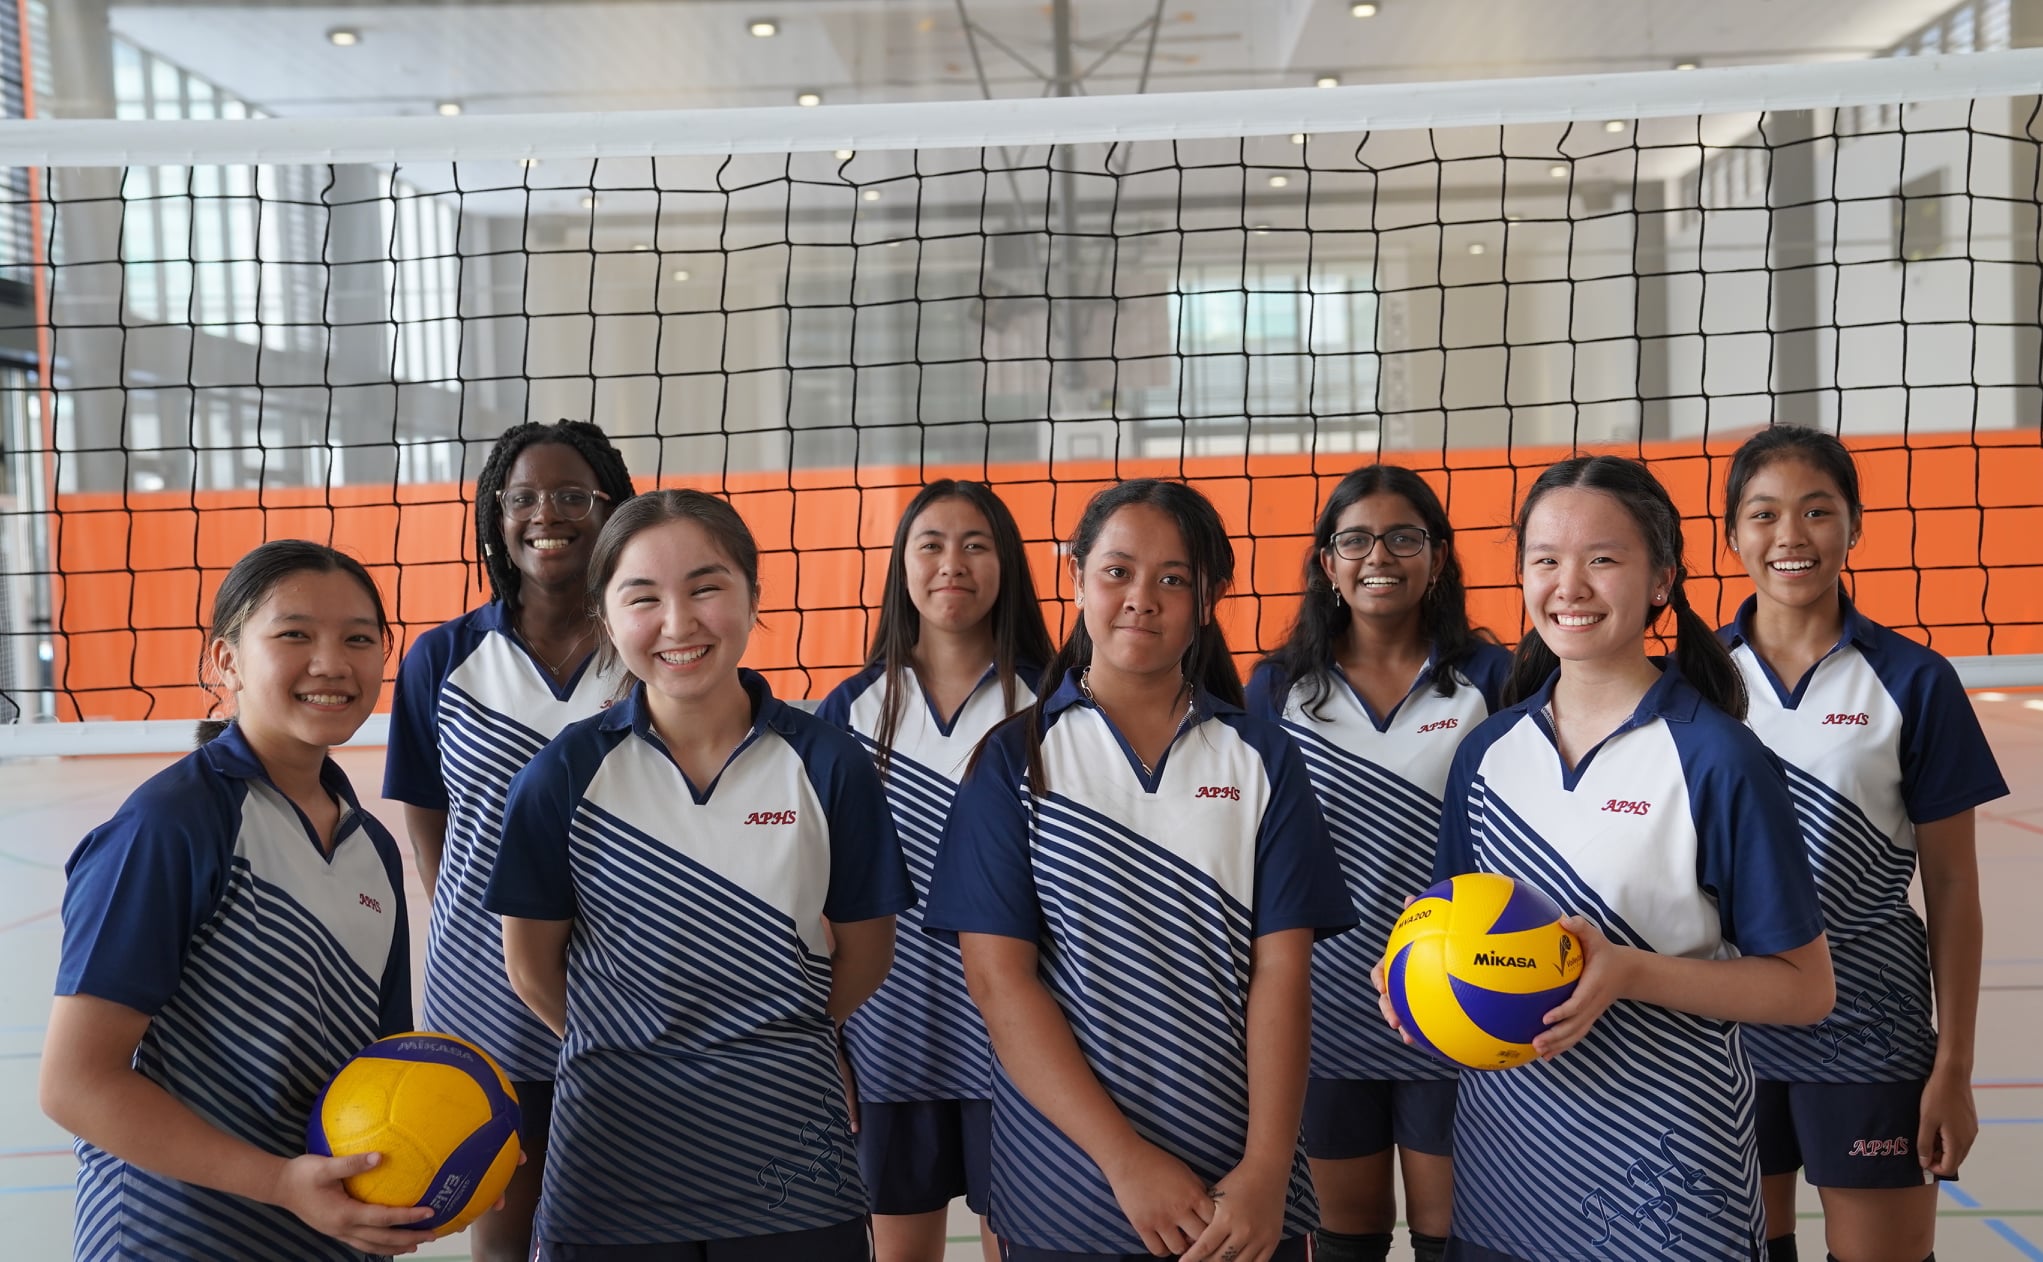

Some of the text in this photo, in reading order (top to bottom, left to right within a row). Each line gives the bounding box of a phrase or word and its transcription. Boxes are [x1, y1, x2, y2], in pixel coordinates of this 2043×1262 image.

[1417, 718, 1458, 734] APHS
[1822, 712, 1869, 726] APHS
[1195, 786, 1241, 801] APHS
[1601, 799, 1652, 816] APHS
[744, 810, 797, 825] APHS
[359, 893, 382, 914] APHS
[1473, 950, 1537, 969] MiKASA
[1848, 1136, 1909, 1157] APHS
